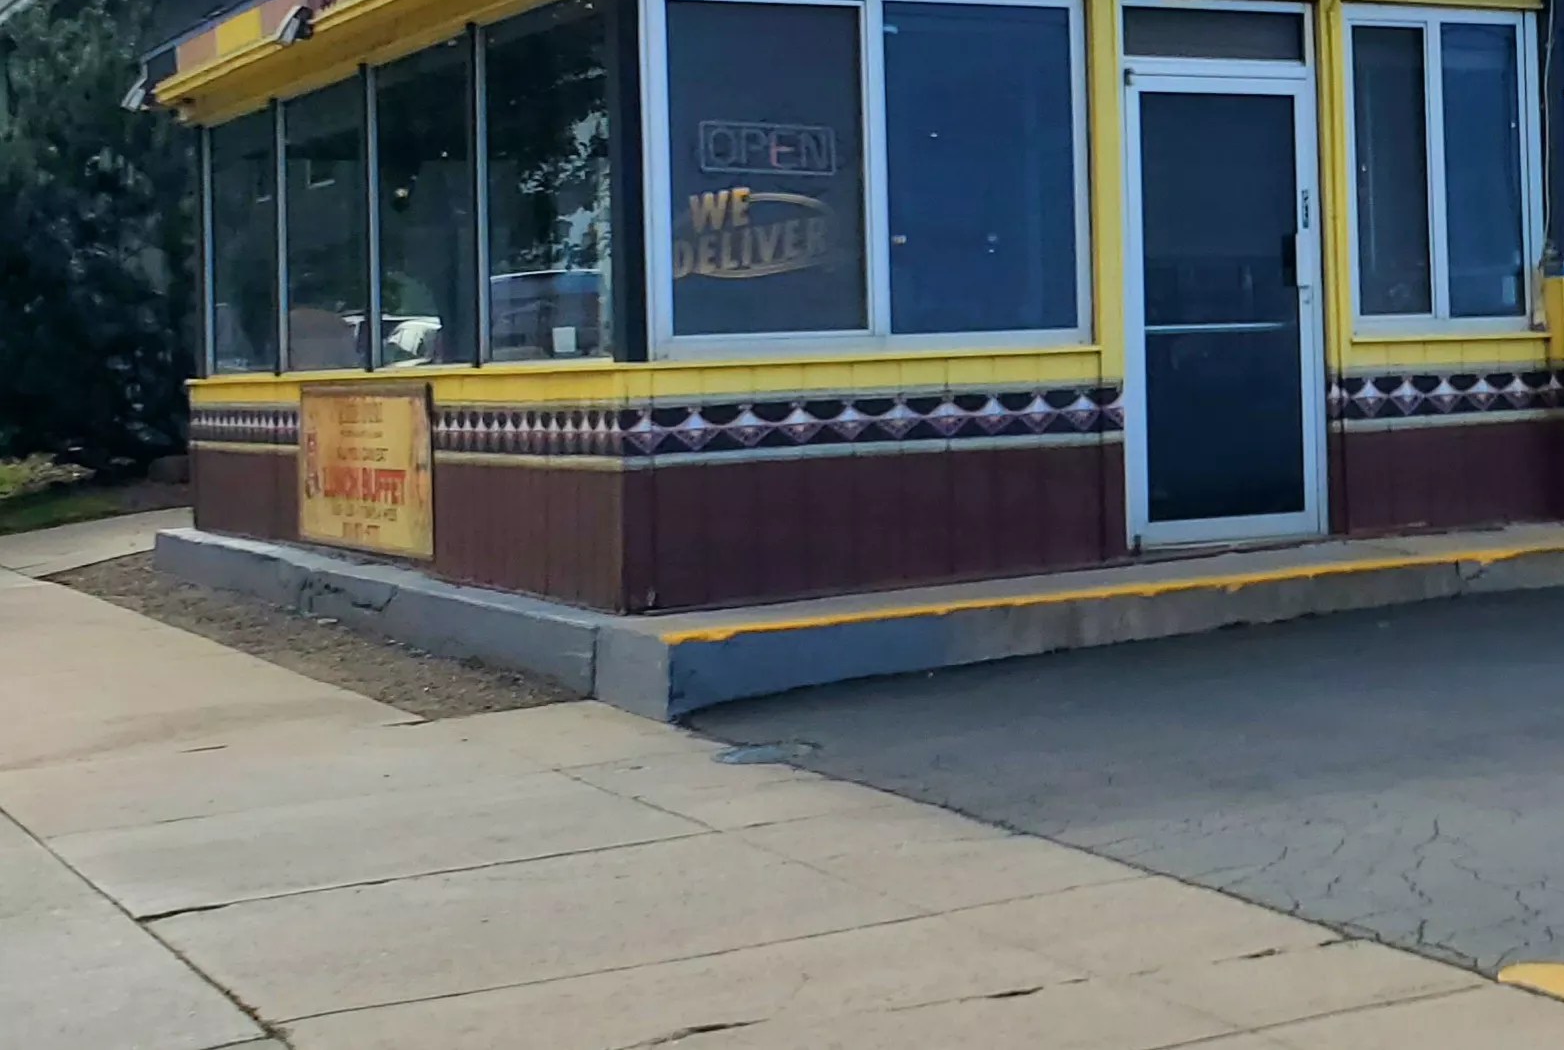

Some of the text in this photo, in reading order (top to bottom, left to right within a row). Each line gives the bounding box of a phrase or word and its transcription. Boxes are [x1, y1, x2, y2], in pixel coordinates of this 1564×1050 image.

[709, 128, 829, 169] OPEN
[688, 187, 751, 233] WE
[673, 217, 828, 279] DELIVER
